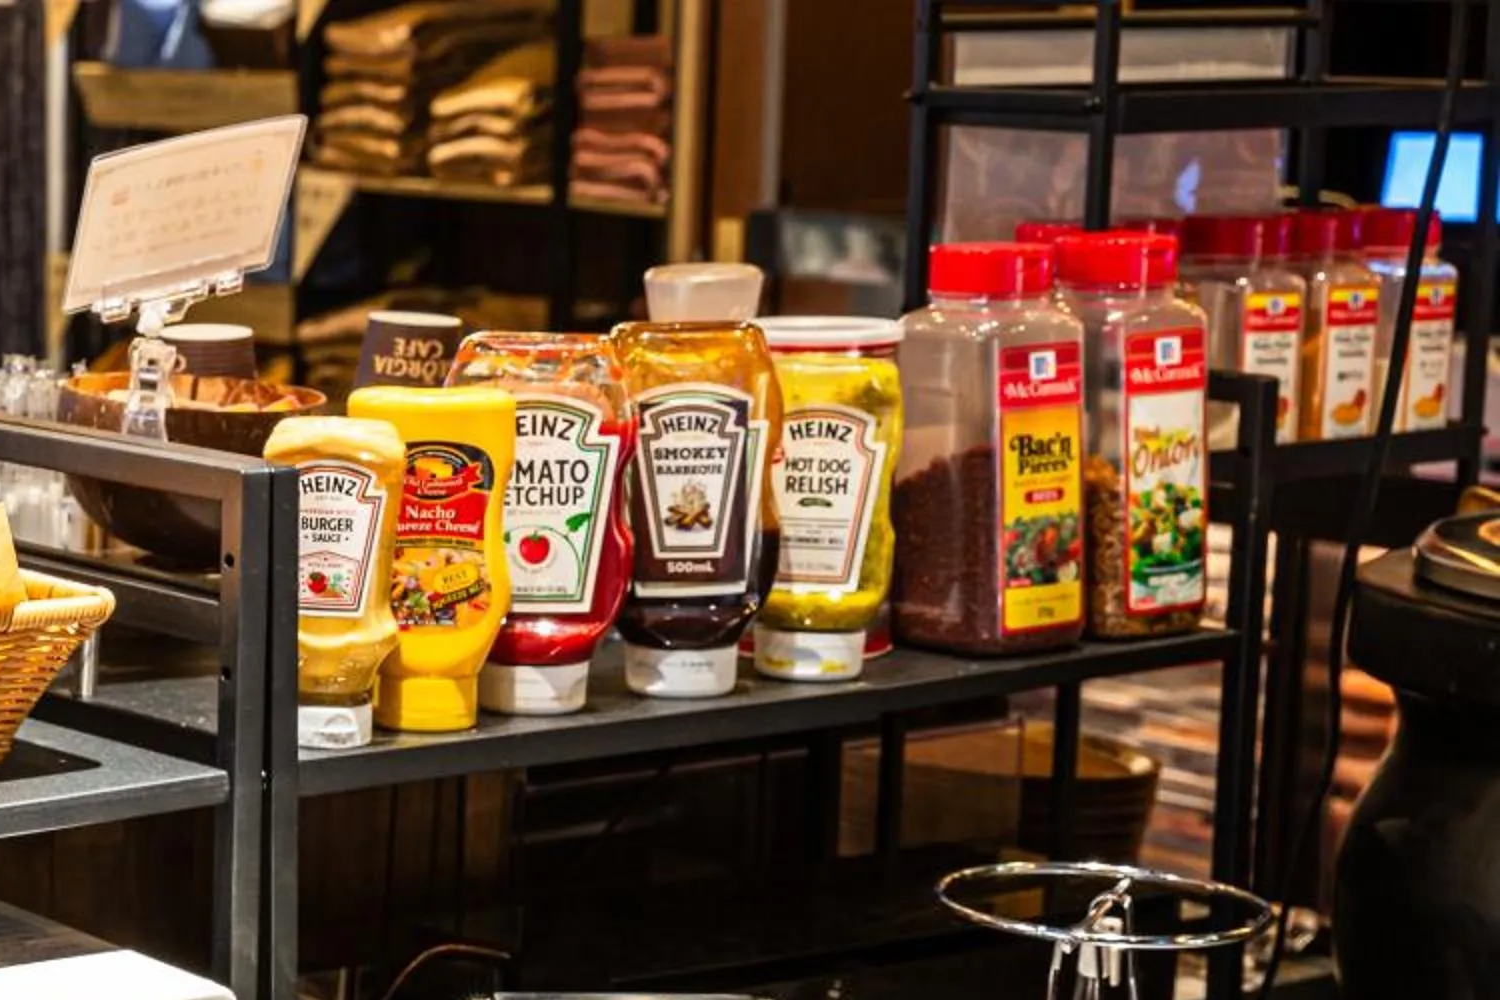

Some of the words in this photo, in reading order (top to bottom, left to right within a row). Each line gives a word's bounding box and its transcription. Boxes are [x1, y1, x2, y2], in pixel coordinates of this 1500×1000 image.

[515, 414, 577, 441] EINZ
[661, 415, 722, 434] HEINZ
[788, 421, 854, 443] HEINZ
[653, 446, 728, 461] SMOKEY
[514, 458, 590, 485] MATO
[785, 457, 815, 473] HOT
[817, 458, 851, 474] DOG
[301, 475, 357, 497] HEINZ
[784, 474, 850, 496] RELISH
[405, 505, 457, 519] Nacho
[301, 516, 354, 533] BURGER
[311, 533, 341, 544] SAUCE
